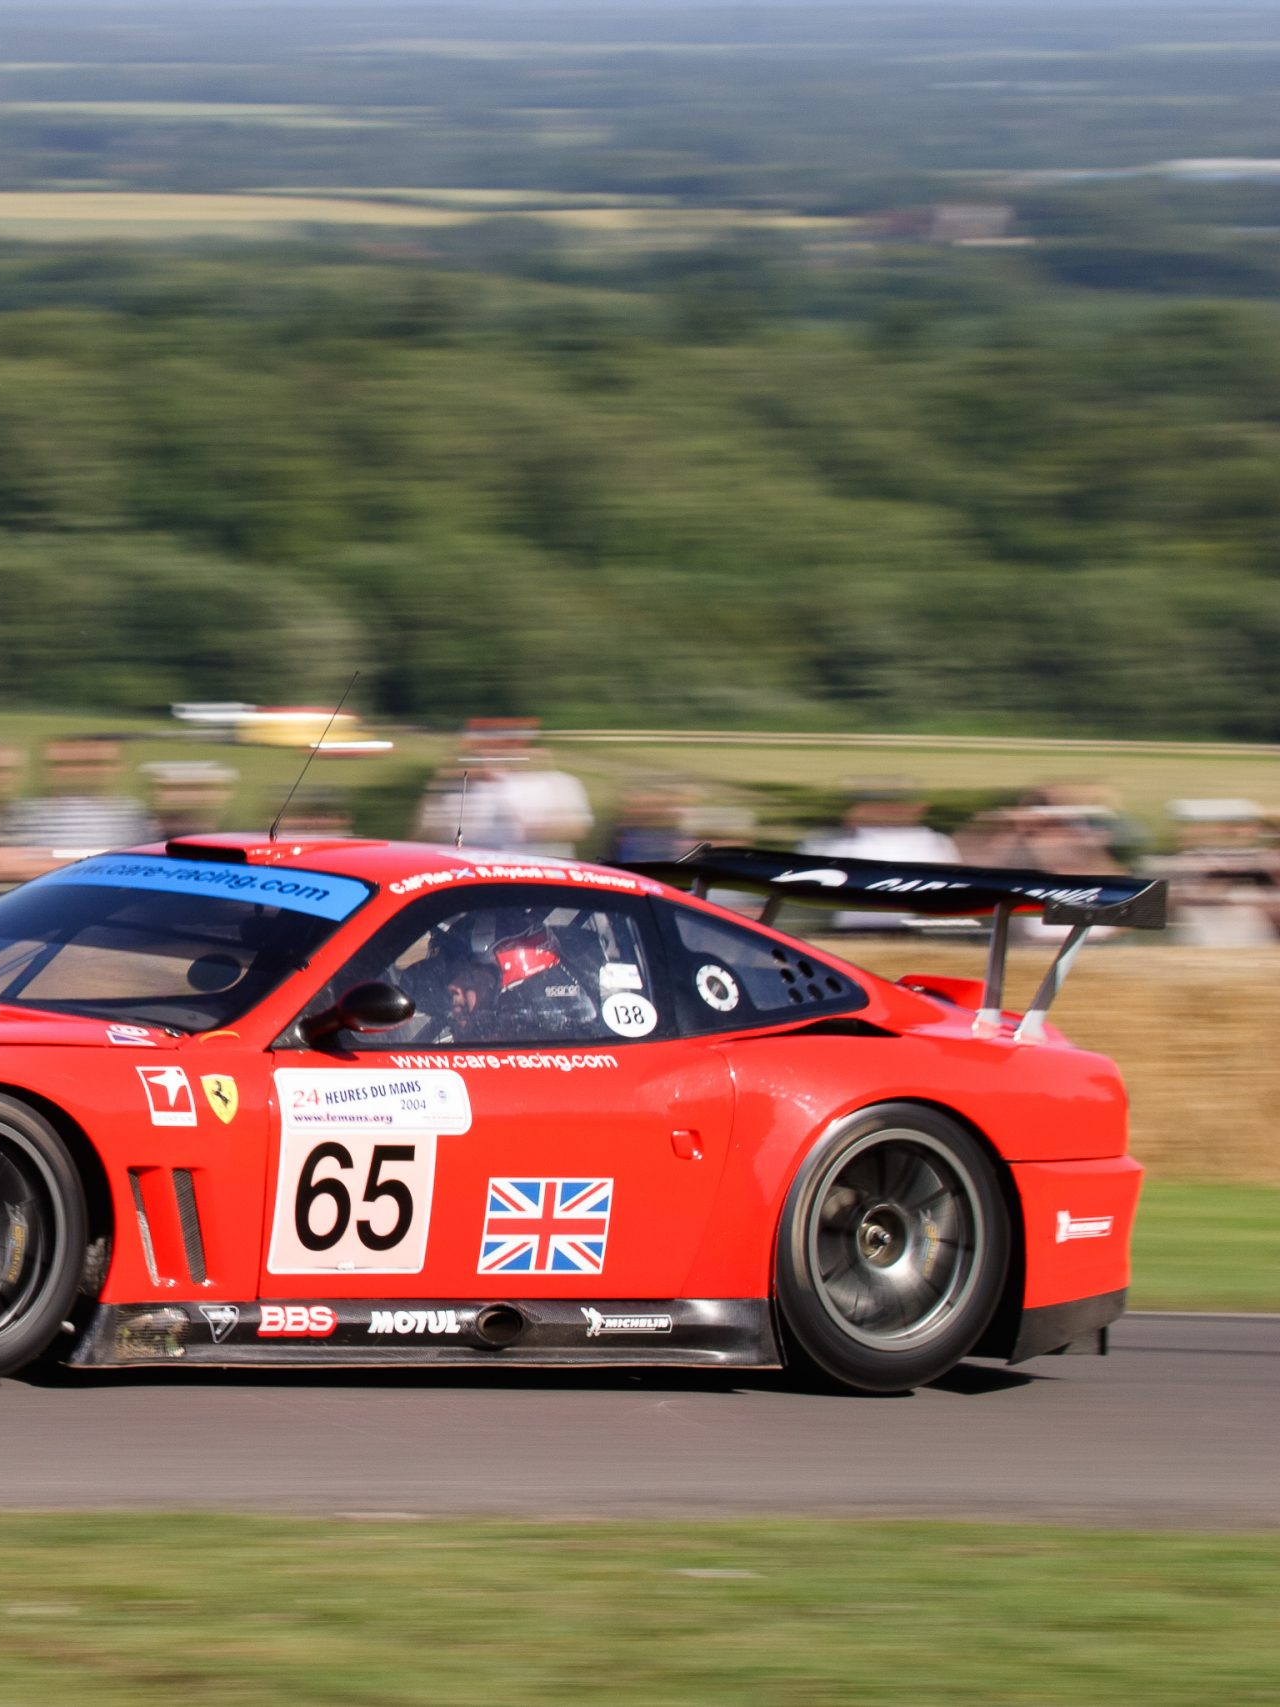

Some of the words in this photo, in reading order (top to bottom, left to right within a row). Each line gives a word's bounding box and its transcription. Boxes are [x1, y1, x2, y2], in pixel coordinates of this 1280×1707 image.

[614, 1005, 645, 1025] 138
[390, 1052, 618, 1072] www.care-racing.com
[292, 1088, 321, 1109] 24
[324, 1087, 369, 1105] HEURES
[370, 1085, 387, 1099] DU
[389, 1080, 422, 1096] MANS
[400, 1099, 427, 1110] 2004
[293, 1113, 393, 1124] www.lemans.org
[294, 1141, 416, 1252] 65
[258, 1305, 335, 1333] BBS
[368, 1310, 461, 1334] MOTUL
[605, 1318, 669, 1328] MICHELIN
